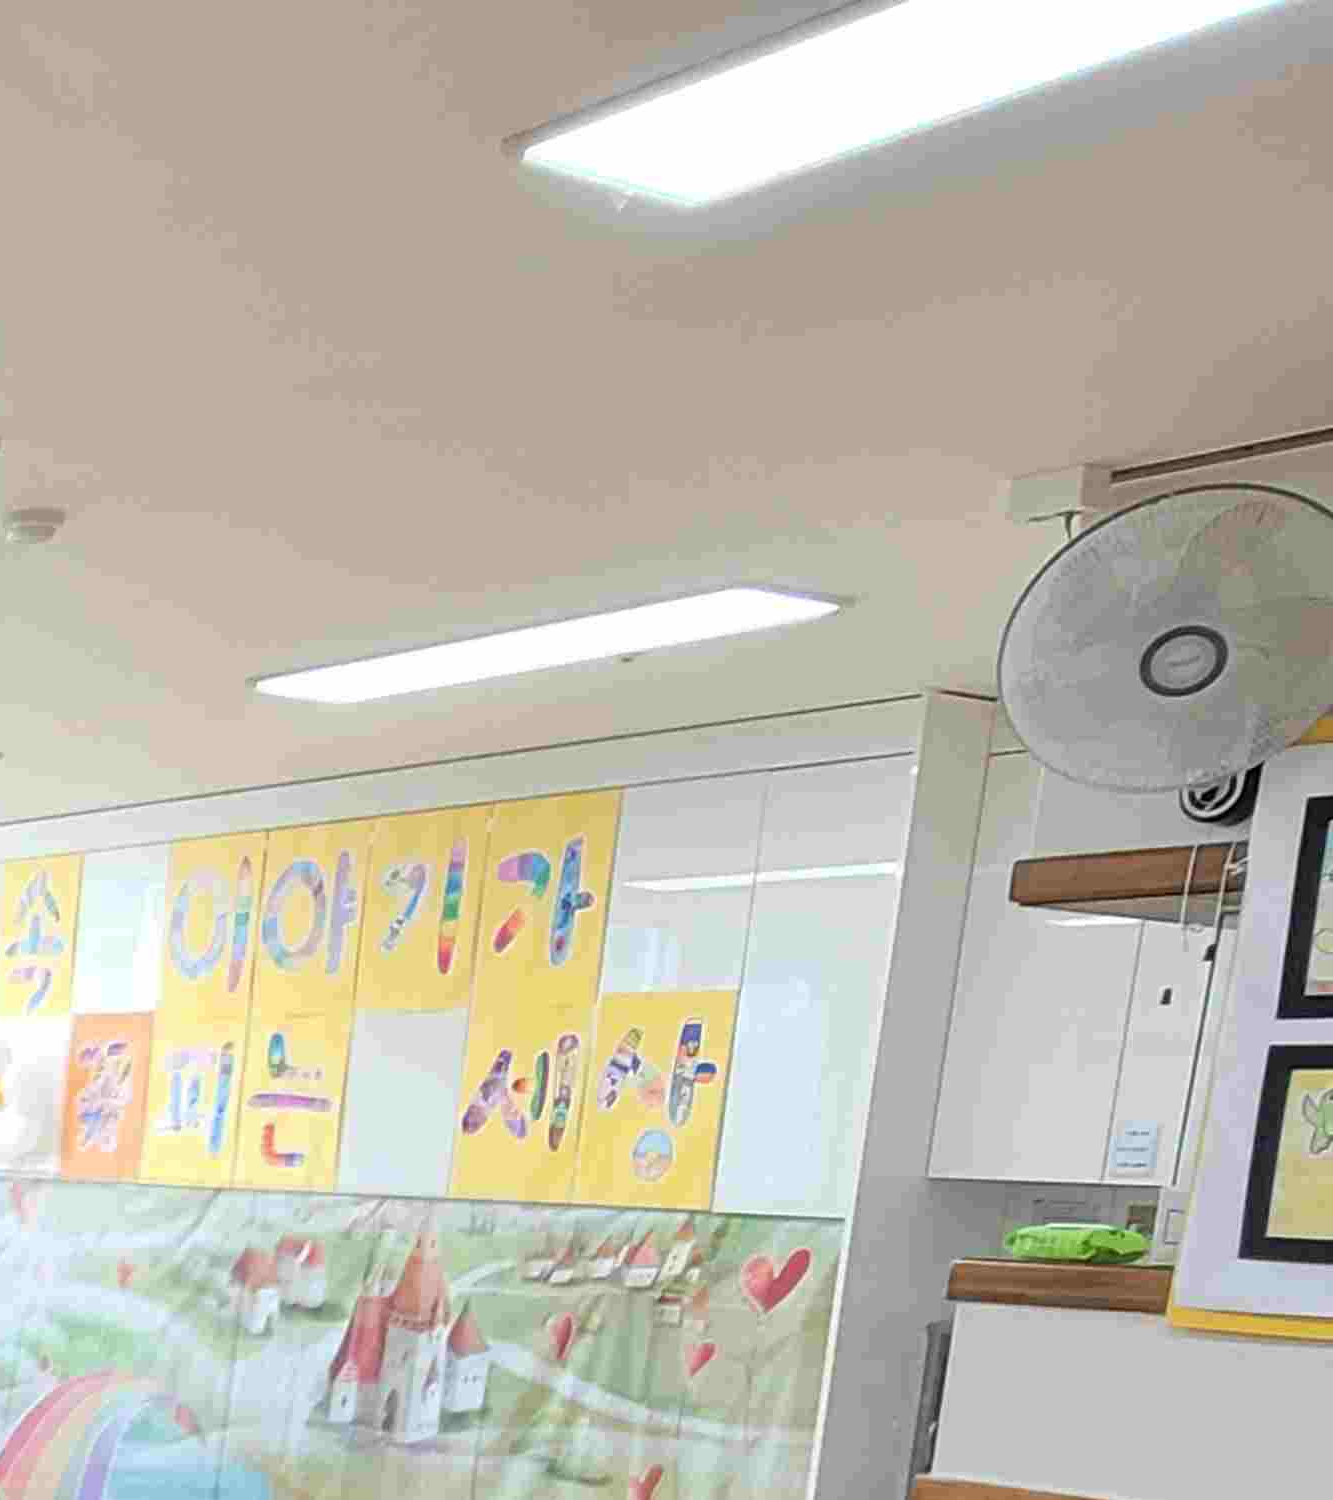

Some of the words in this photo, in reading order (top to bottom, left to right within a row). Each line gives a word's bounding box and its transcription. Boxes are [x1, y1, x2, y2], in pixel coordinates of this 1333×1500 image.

[3, 869, 65, 1017] 속
[167, 833, 597, 994] 이야기가
[460, 1017, 718, 1183] 세상
